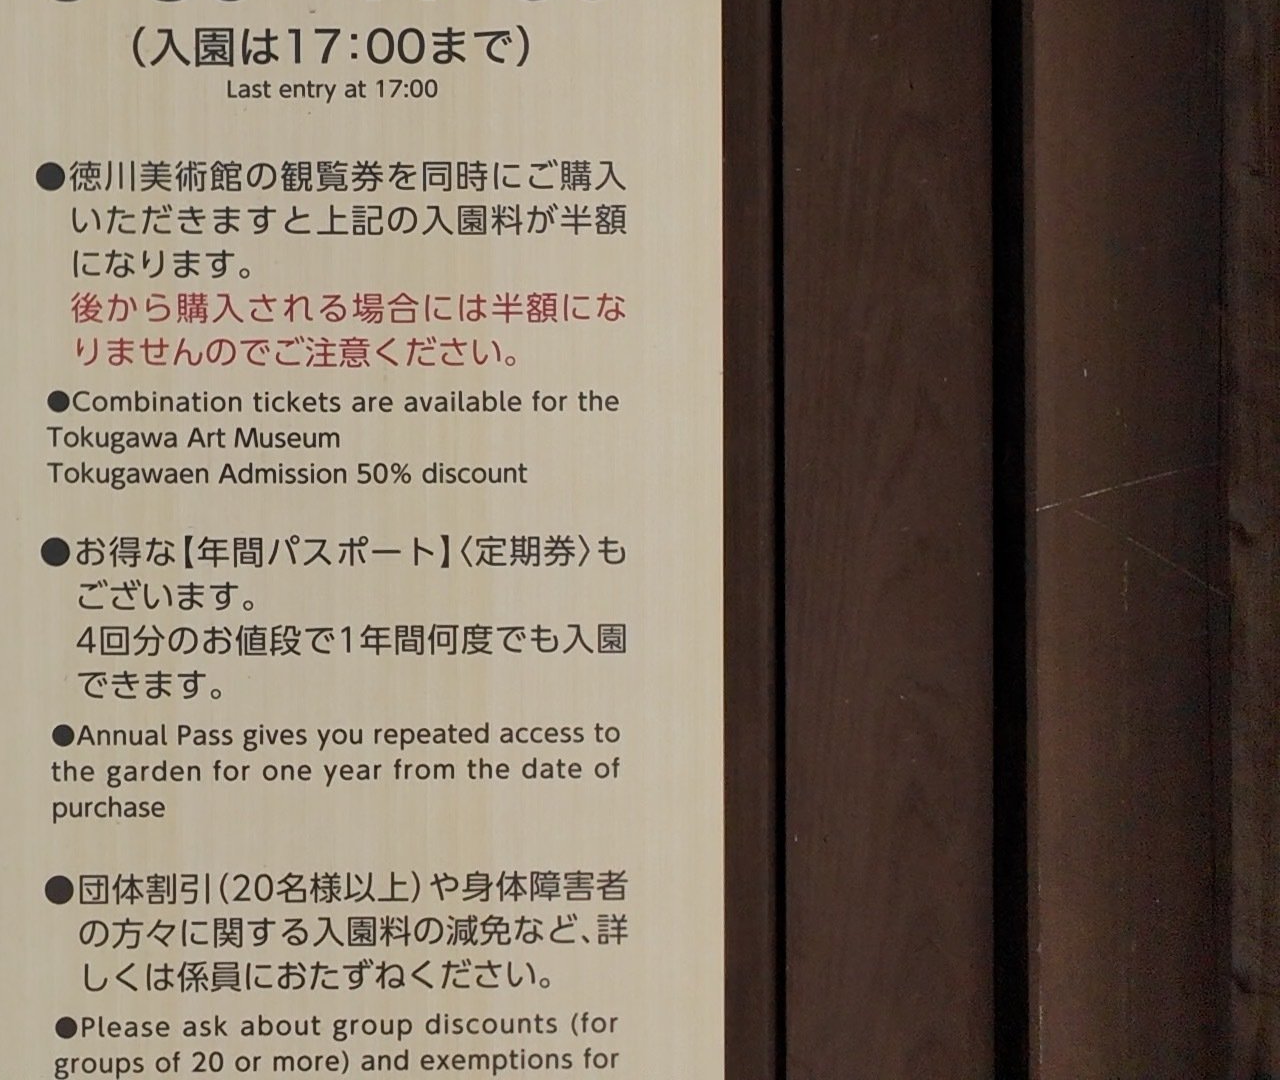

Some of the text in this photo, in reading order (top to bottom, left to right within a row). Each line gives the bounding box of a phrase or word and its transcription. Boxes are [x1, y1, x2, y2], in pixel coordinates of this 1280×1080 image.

[227, 78, 438, 104] Last entry at 17:00
[71, 202, 627, 236] いただきますと上記の入園料が半額
[73, 249, 250, 280] になります。
[70, 291, 626, 325] 後から購入される場合には半額にな
[76, 335, 516, 369] りませんのでご注意ください。
[72, 389, 620, 413] Combination tickets are available for the
[46, 425, 340, 455] Tokugawa Art Museum
[46, 461, 528, 491] Tokugawaen Admission 50% discount
[78, 578, 254, 612] ございます。
[76, 623, 627, 657] 4回分のお値段で1年間何度でも入園
[77, 669, 222, 700] できます。
[76, 721, 621, 752] Annual Pass gives you repeated access to
[51, 756, 620, 789] the garden for one year from the date of
[52, 795, 166, 825] purchase
[84, 958, 550, 993] しくは係員におたずねください。
[81, 1011, 619, 1042] Please ask about group discounts (for
[54, 1047, 620, 1080] groups of 20 or more) and exemptions for
